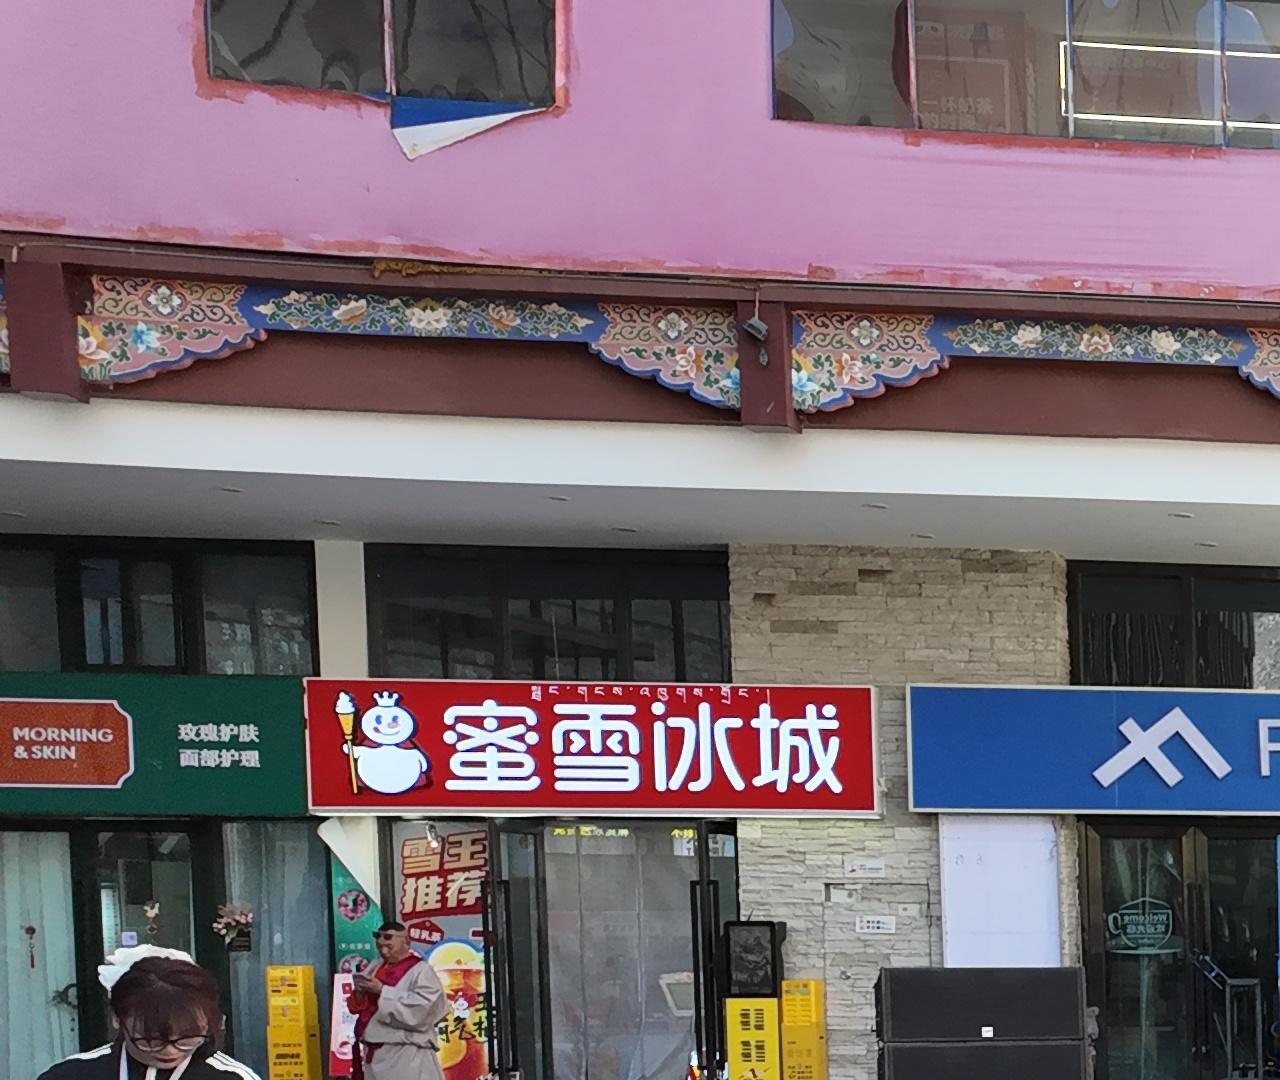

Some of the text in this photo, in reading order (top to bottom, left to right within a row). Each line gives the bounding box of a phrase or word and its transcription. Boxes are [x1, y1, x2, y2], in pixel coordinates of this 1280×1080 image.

[12, 726, 114, 743] MORNING
[177, 722, 261, 744] 玫瑰护肤
[13, 745, 77, 760] & SKIN
[178, 747, 261, 768] 面部护理
[442, 699, 844, 795] 蜜雪冰城
[401, 868, 486, 914] 推荐
